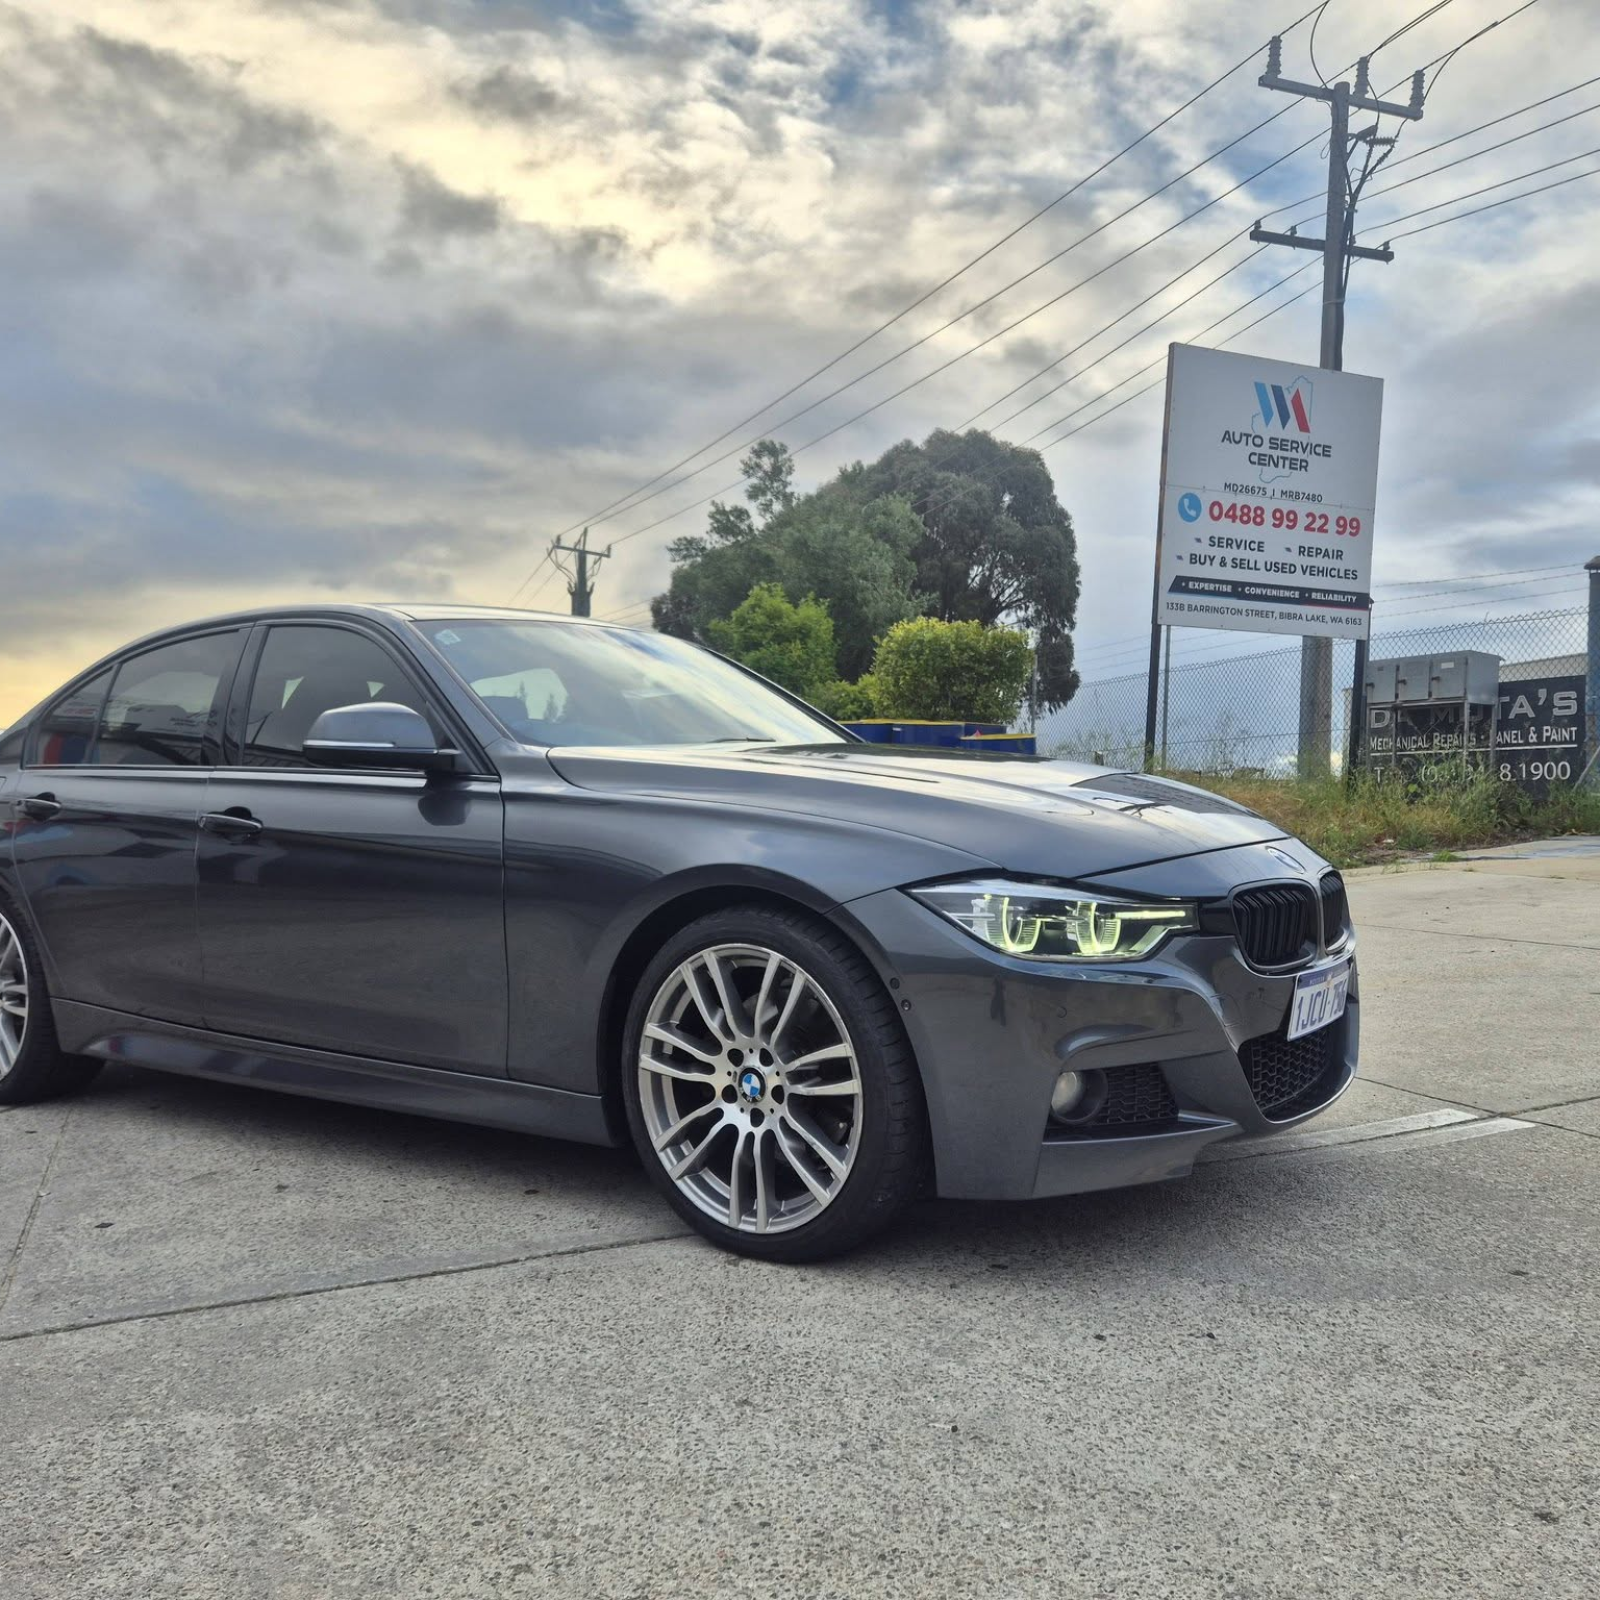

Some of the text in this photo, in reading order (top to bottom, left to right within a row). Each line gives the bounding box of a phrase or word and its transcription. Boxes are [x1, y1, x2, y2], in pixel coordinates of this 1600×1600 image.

[1221, 430, 1332, 458] AUTO SERVICE
[1248, 452, 1309, 472] CENTER
[1224, 482, 1267, 496] MD26675
[1280, 489, 1323, 503] MRB7480
[1209, 500, 1360, 537] 0488 99 22 99
[1208, 536, 1344, 561] SERVICE REPAIR
[1189, 553, 1358, 581] BUY & SELL USED VEHICLES
[1188, 581, 1357, 603] EXPERTISE CONVENIENCE RELIABILITY
[1166, 602, 1362, 626] 133B BARRINGTON STREET, BIBRA LAKE, WA 6163
[1433, 732, 1476, 749] REPAIS
[1496, 730, 1524, 744] ANEL
[1528, 726, 1537, 743] &
[1542, 726, 1578, 743] PAINT
[1519, 760, 1571, 781] 1900
